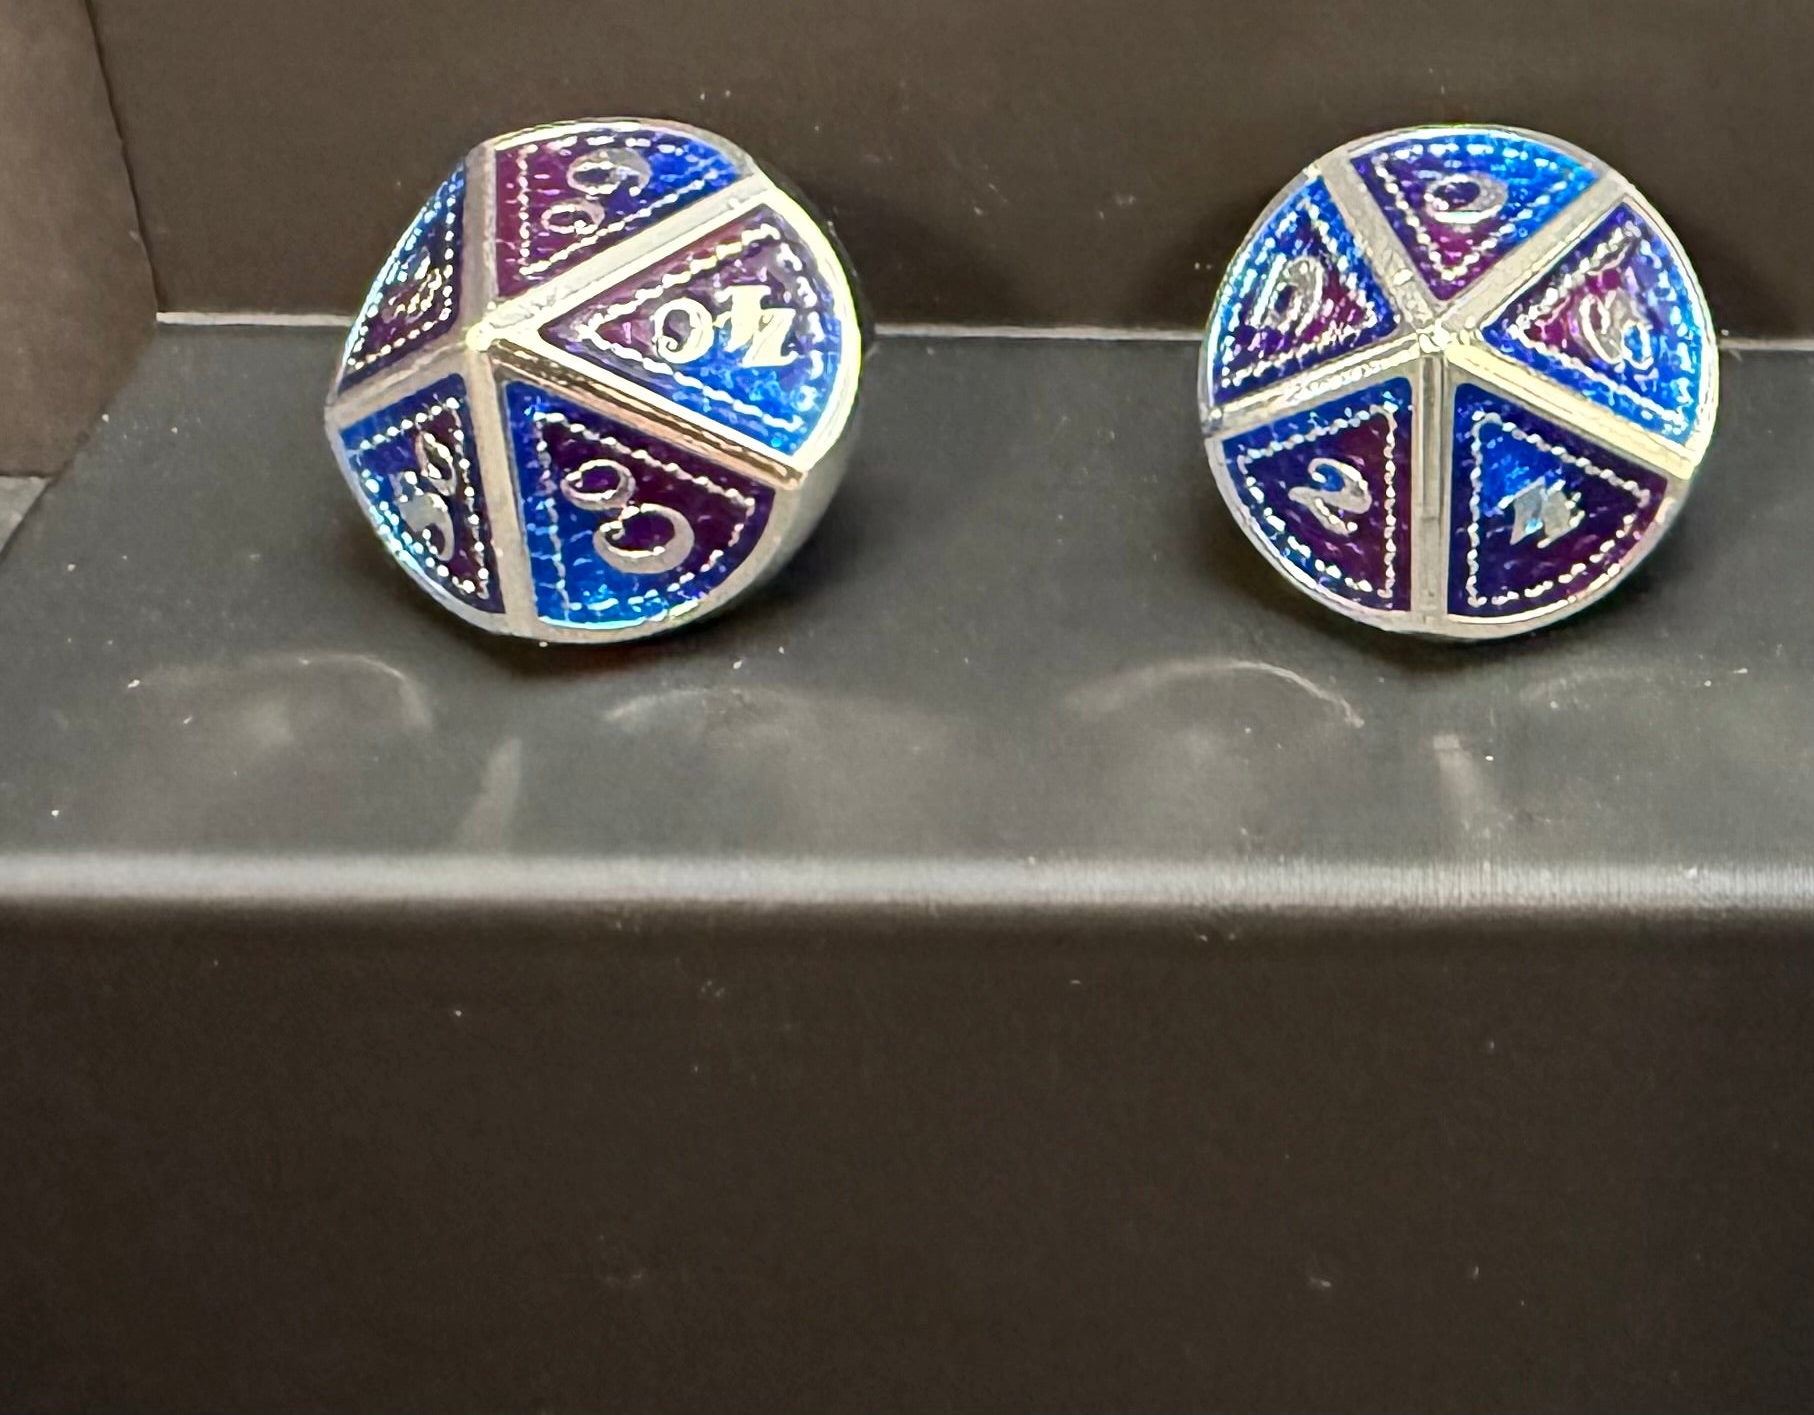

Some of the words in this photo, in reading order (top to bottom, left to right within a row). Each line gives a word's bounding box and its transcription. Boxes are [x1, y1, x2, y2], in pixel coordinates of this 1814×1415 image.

[1425, 171, 1510, 225] 0
[652, 284, 798, 368] 40
[560, 458, 695, 575] 00
[1288, 457, 1373, 537] 2
